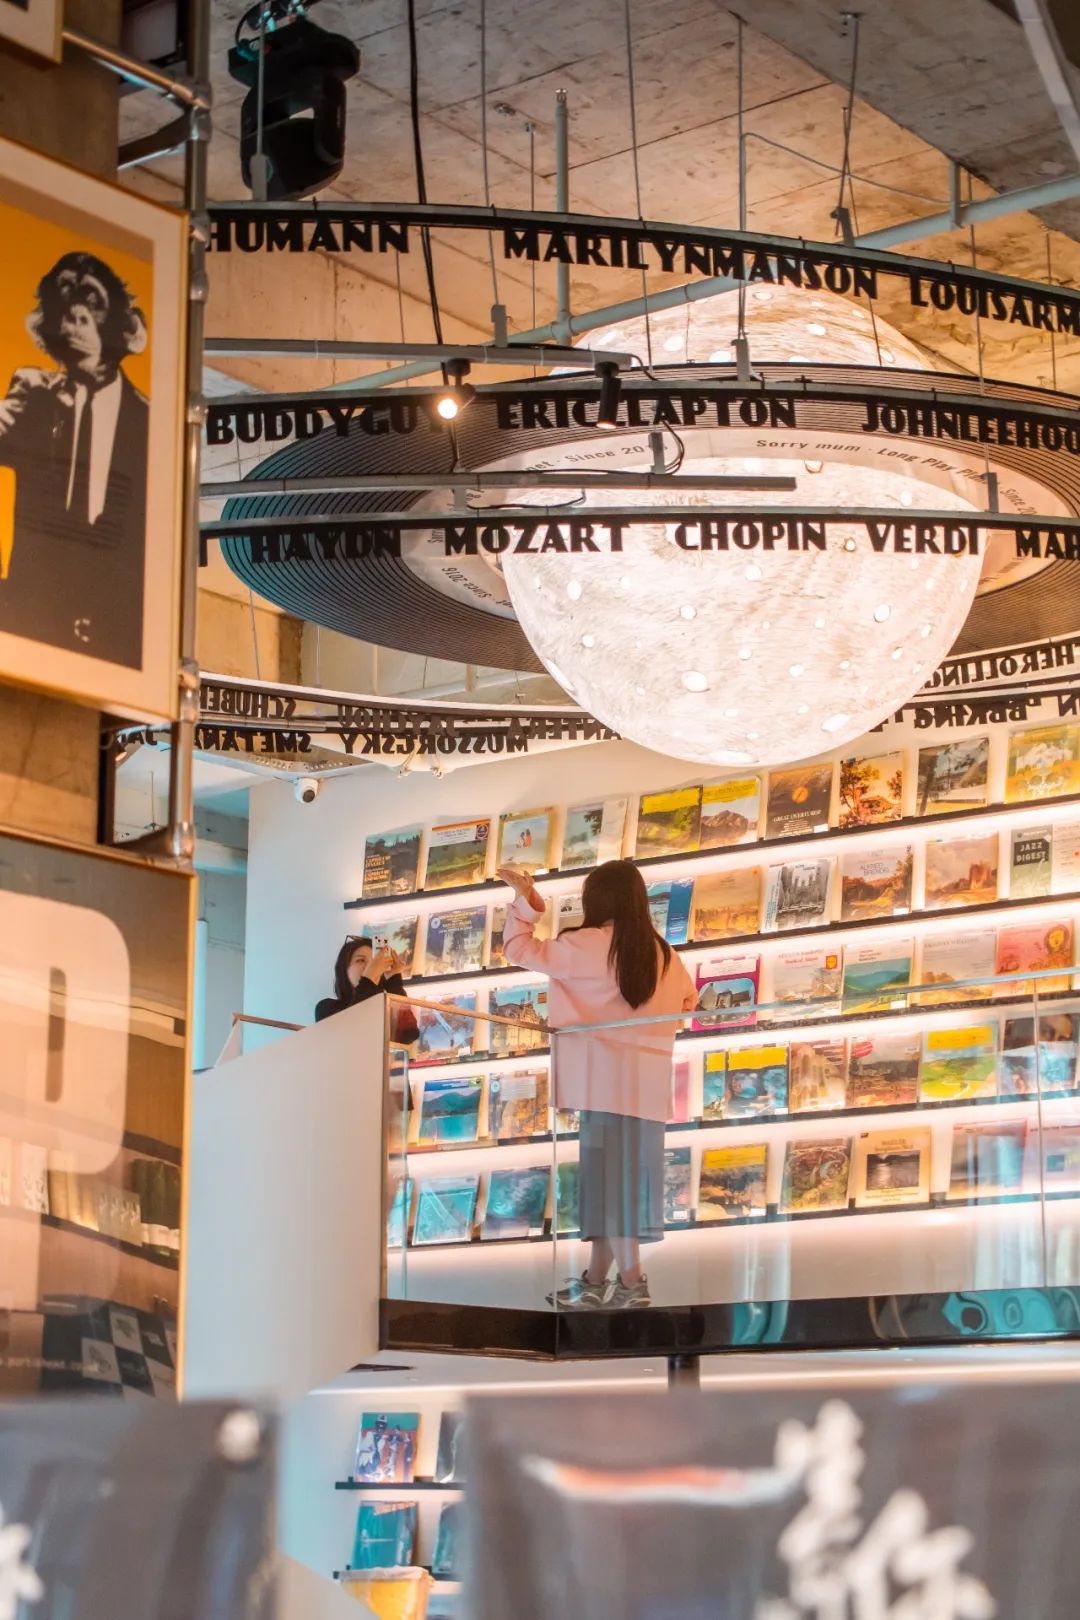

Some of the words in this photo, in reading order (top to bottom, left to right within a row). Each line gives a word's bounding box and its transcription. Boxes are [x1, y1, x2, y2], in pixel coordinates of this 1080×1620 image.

[503, 224, 878, 299] MARILYNMANSON
[497, 398, 796, 428] ERICLAPTON
[756, 438, 808, 449] Sorry
[815, 442, 862, 452] mum
[877, 447, 919, 463] Long
[922, 457, 957, 475] Play
[251, 529, 401, 563] HAYDN
[445, 522, 630, 556] MOZART
[674, 521, 827, 551] CHOPIN
[865, 522, 979, 555] VERDI
[1016, 851, 1046, 862] DIGEST
[1020, 842, 1043, 852] JAZZ
